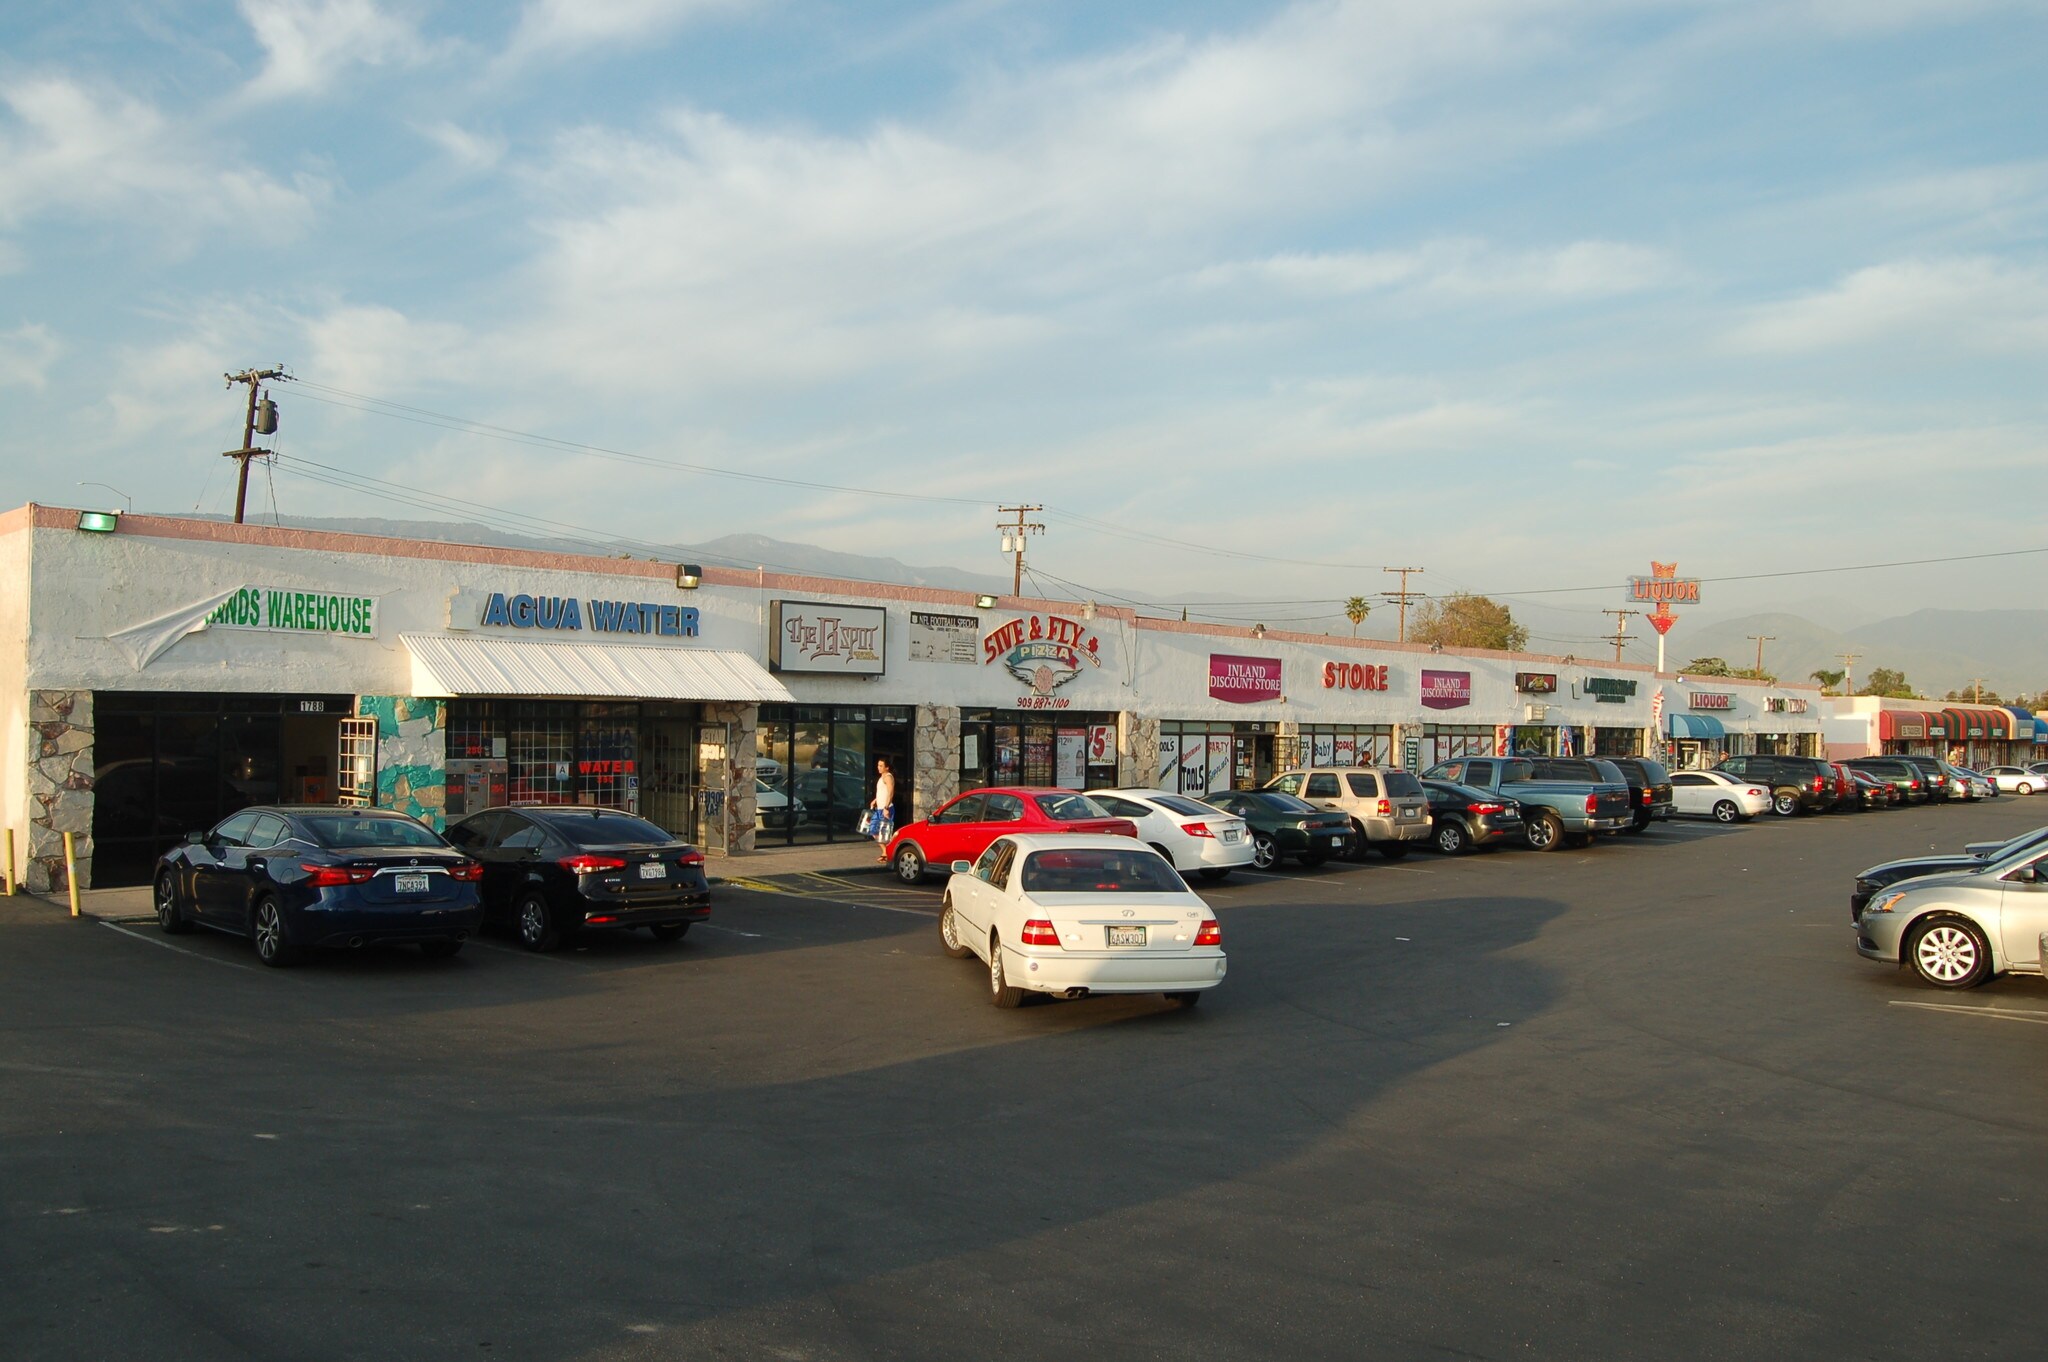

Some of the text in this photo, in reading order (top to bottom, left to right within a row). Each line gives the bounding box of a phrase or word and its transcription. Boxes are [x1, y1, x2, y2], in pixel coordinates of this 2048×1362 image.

[1634, 580, 1698, 601] LIQUOR
[267, 590, 372, 634] WAREHOUSE
[481, 592, 700, 637] AGUA WATER
[1029, 615, 1043, 641] &
[1046, 615, 1086, 650] FLY
[1020, 645, 1070, 660] PIZZA
[1227, 664, 1266, 679] INLAND
[1322, 661, 1388, 692] STORE
[1210, 675, 1281, 690] DISCOUNT STORE
[1433, 677, 1461, 689] INLAND
[1422, 687, 1471, 699] DISCOUNT STORE
[1694, 693, 1729, 708] LIQUOR
[301, 701, 324, 711] 1788
[1016, 697, 1032, 708] 909
[579, 760, 635, 775] WATER
[1182, 764, 1204, 791] TOOLS
[1111, 933, 1144, 945] 6ASW307
